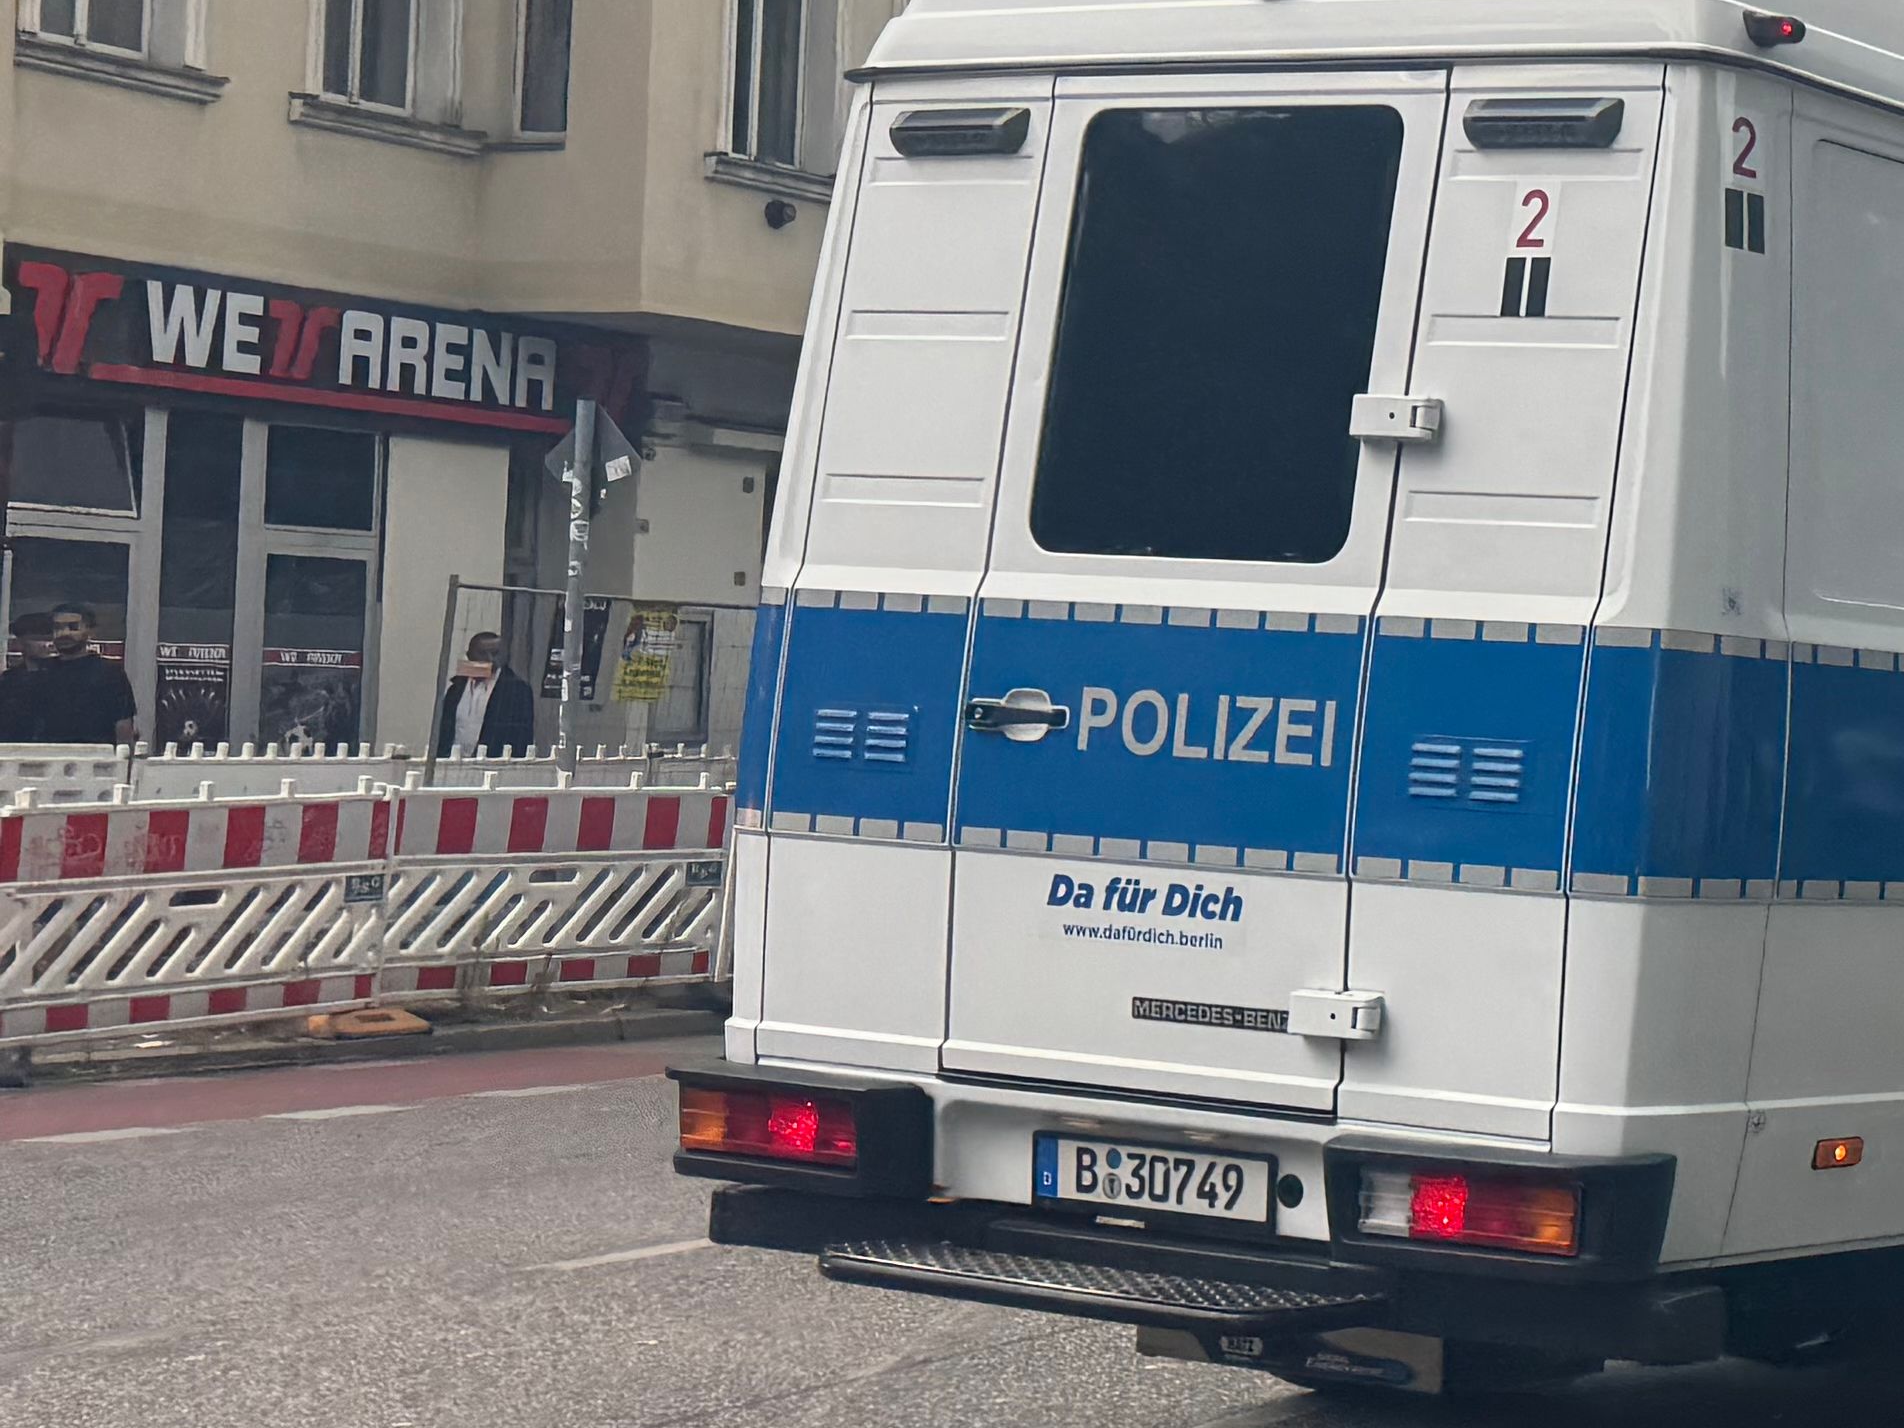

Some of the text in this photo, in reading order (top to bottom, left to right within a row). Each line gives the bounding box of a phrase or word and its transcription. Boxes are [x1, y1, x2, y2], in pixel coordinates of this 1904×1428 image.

[1732, 117, 1757, 179] 2
[1516, 189, 1549, 247] 2
[1077, 685, 1337, 768] POLIZEI
[1047, 874, 1243, 922] Da für Dich
[1076, 1146, 1244, 1211] B 30749
